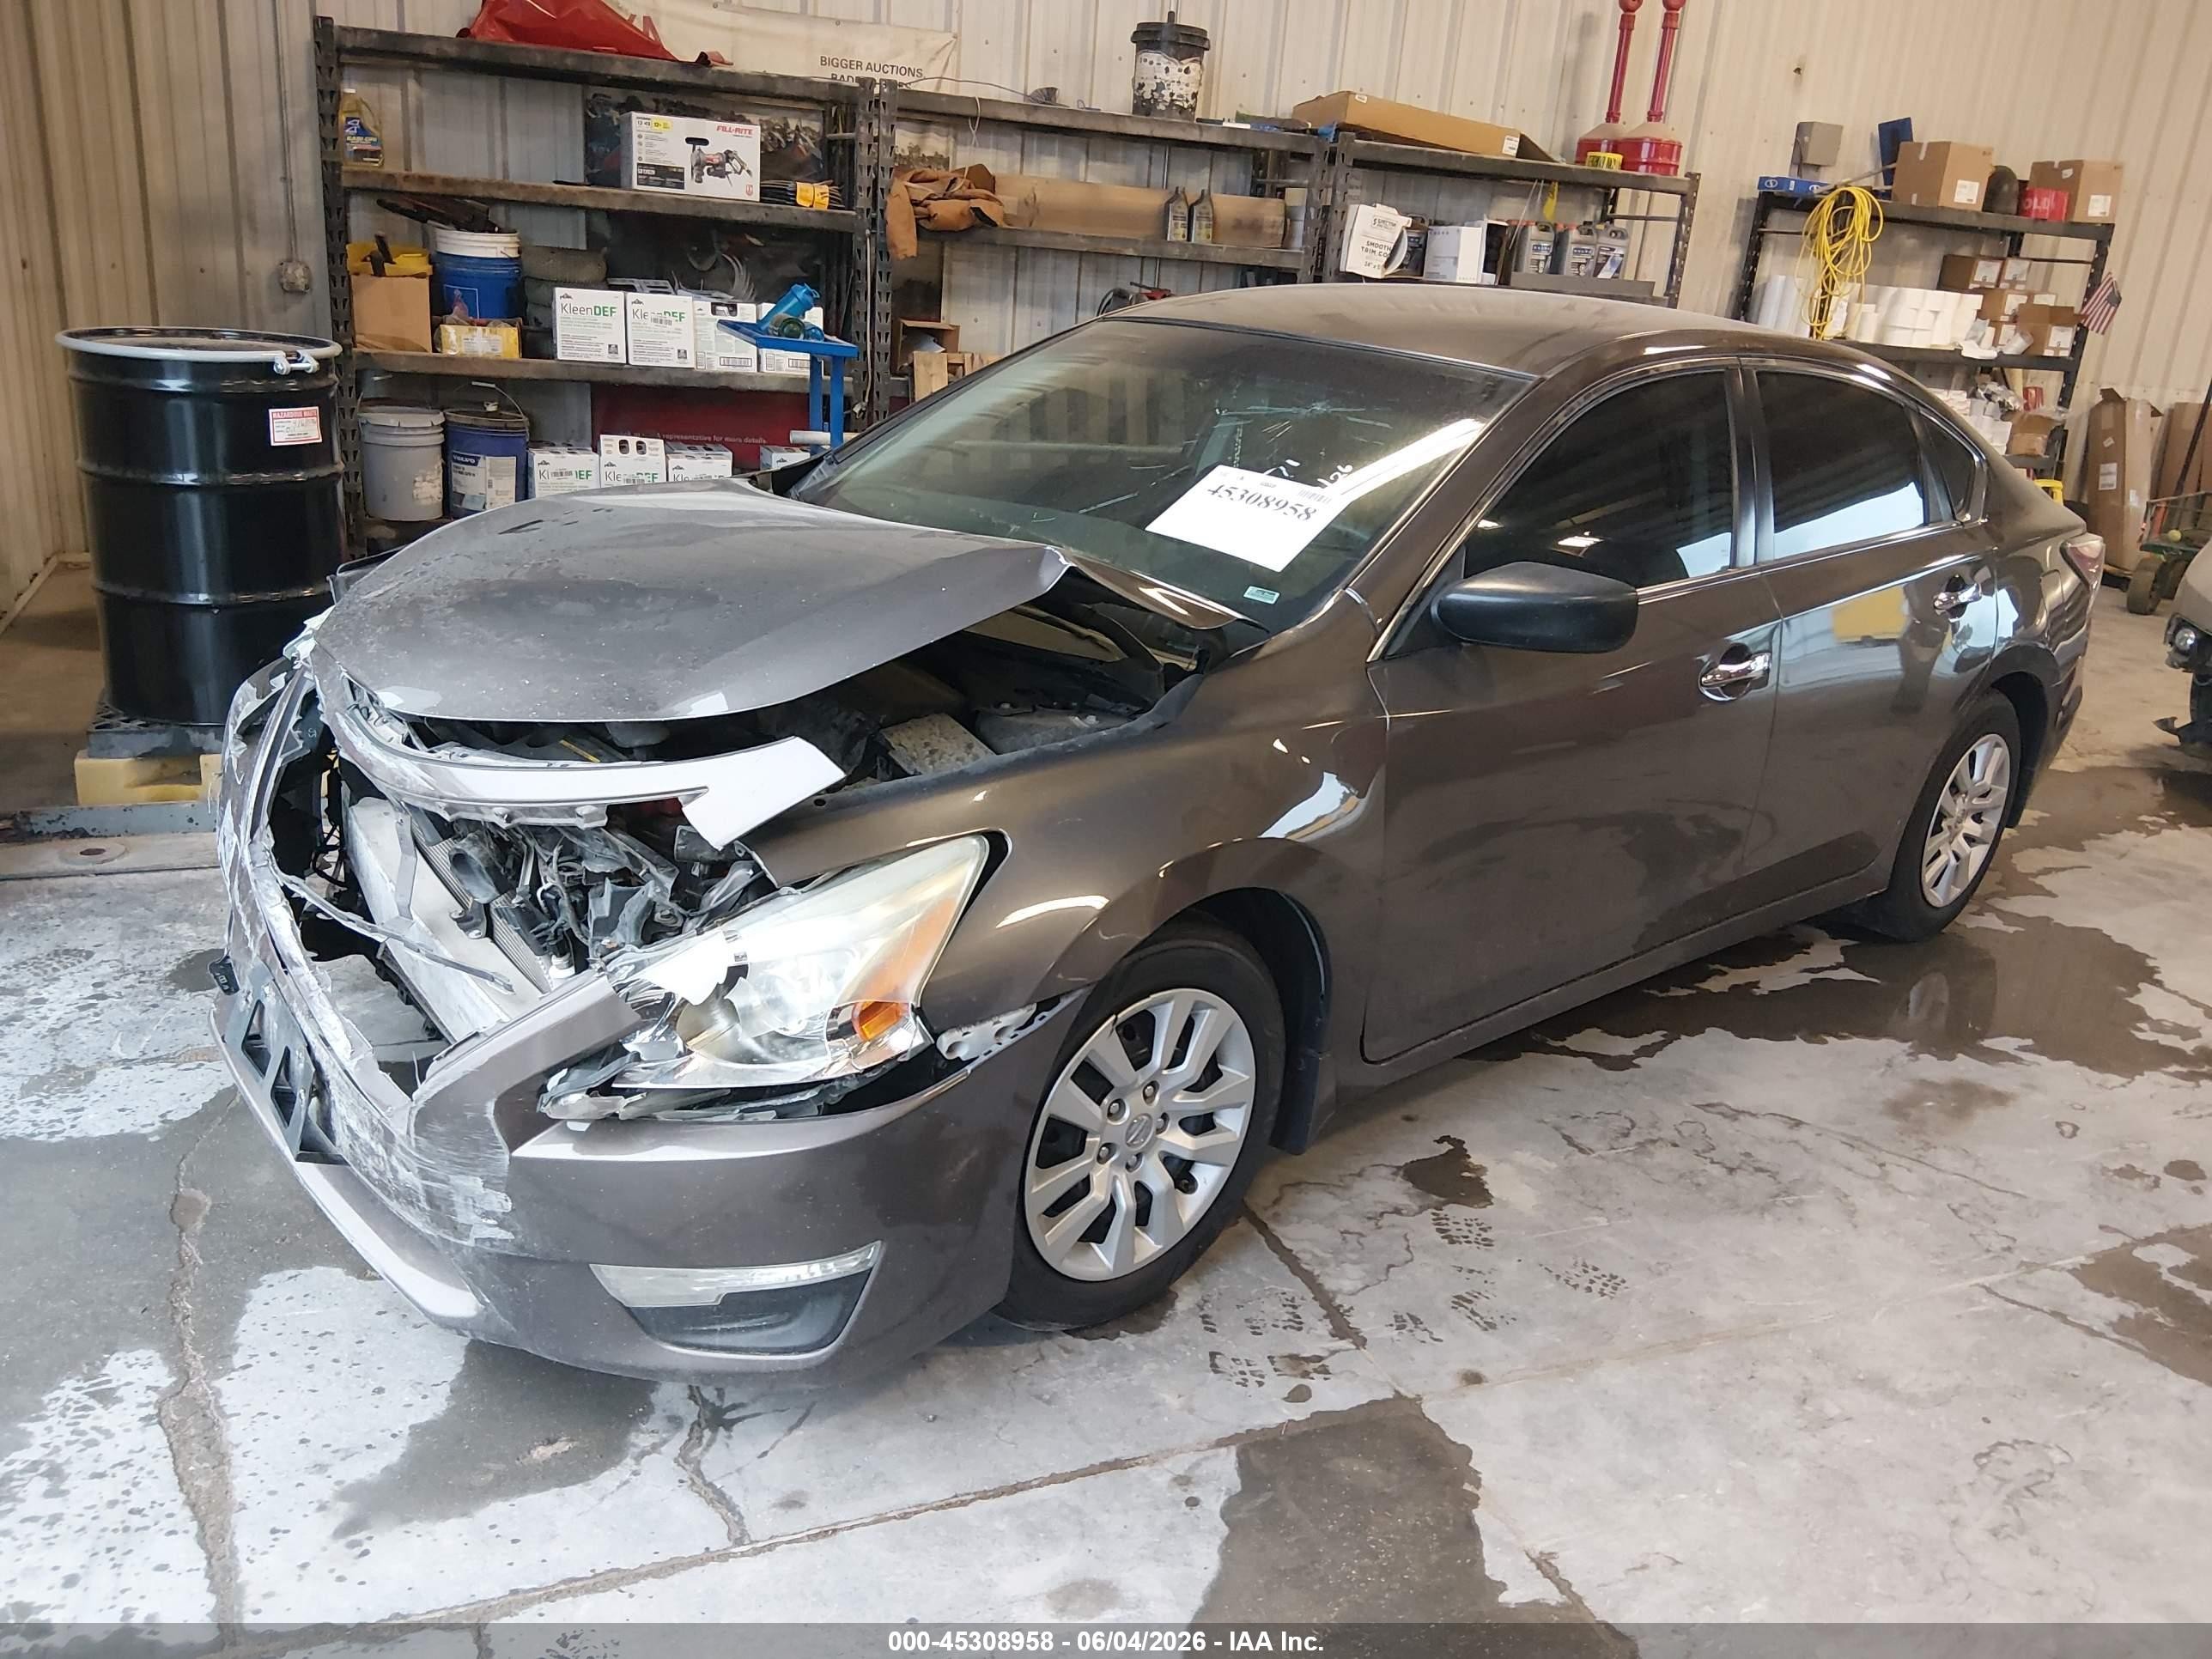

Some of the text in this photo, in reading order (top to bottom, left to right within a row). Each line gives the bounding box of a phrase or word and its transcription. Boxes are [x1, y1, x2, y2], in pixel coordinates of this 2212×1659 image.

[820, 56, 863, 70] BIGGER
[716, 125, 754, 136] FILL-RITE
[1366, 240, 1392, 252] SMOOTH
[560, 301, 617, 317] KleenDEF
[453, 455, 476, 465] VOLVO
[1207, 484, 1317, 520] 45308958
